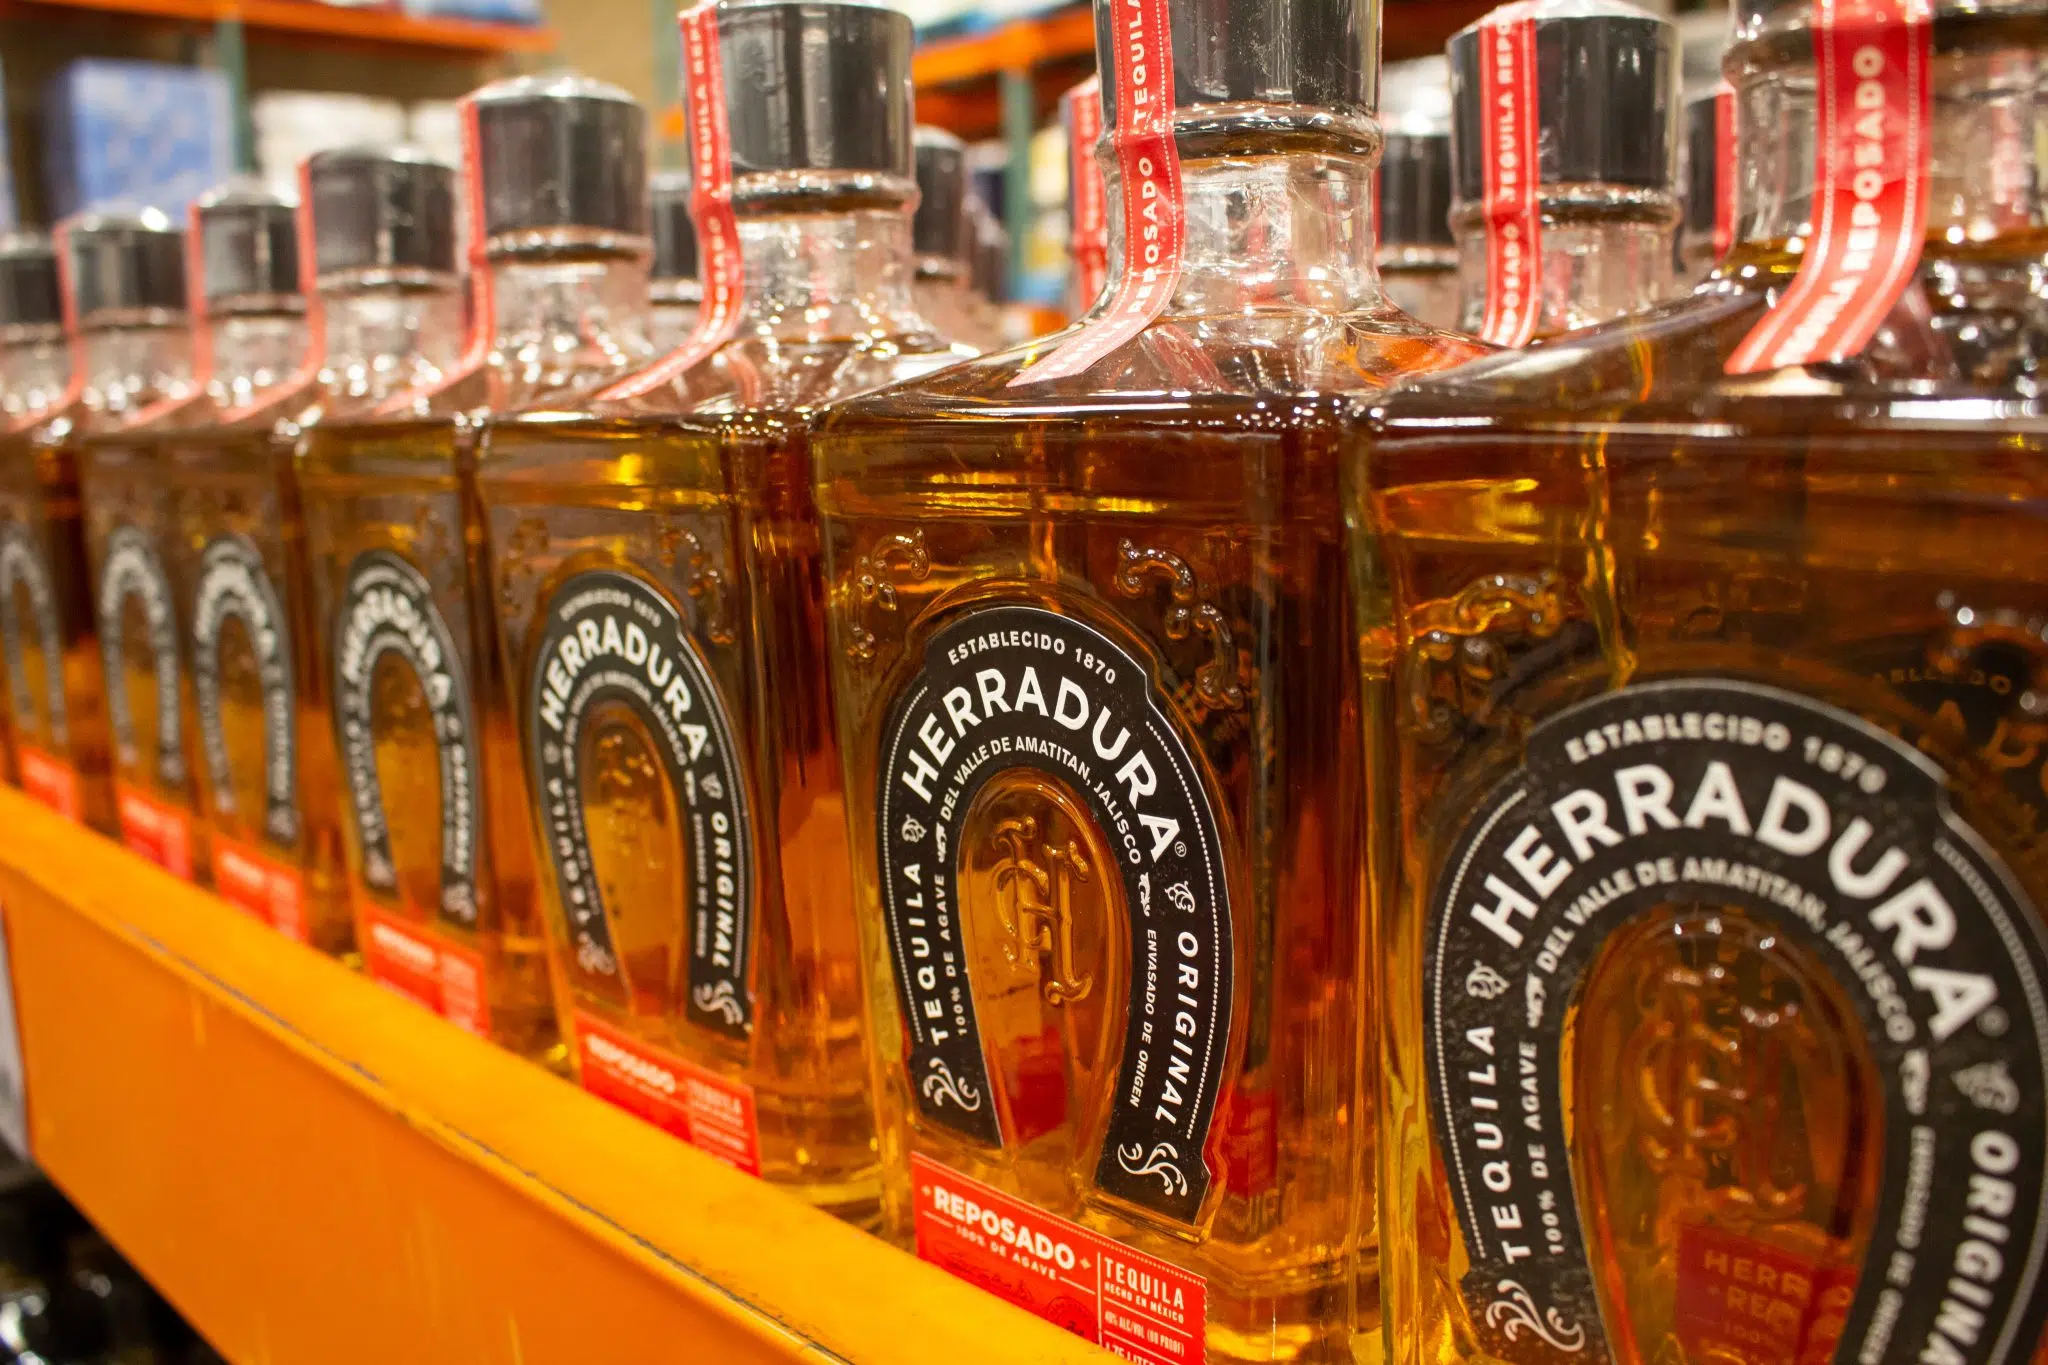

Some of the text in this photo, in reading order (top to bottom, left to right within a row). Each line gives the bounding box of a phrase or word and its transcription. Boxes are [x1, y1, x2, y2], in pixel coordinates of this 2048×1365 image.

[1840, 45, 1885, 272] REPOSADO
[540, 615, 707, 762] HERRADURA
[948, 631, 1117, 685] ESTABLECIDO 1870
[940, 787, 960, 821] DEL
[954, 745, 989, 786] VALLE
[990, 737, 1012, 756] DE
[1094, 781, 1141, 865] JALISCO
[1565, 712, 1790, 764] ESTABLECIDO
[1804, 737, 1888, 794] 1870
[904, 863, 950, 1046] TEQUILA
[934, 874, 968, 1035] 100% DE AGAVE
[1536, 930, 1574, 976] DEL
[1565, 868, 1637, 927] VALLE
[1638, 856, 1679, 887] DE
[1129, 929, 1157, 1108] ENVASADO DE ORIGEN
[1155, 931, 1199, 1125] ORIGINAL
[1466, 1025, 1532, 1265] TEQUILA
[1518, 1041, 1565, 1256] 100% DE AGAVE
[934, 1185, 1075, 1270] REPOSADO
[1012, 1252, 1056, 1280] AGAVE
[1104, 1256, 1184, 1310] TEQUILA
[1104, 1281, 1184, 1324] HECHO EN MÉXICO
